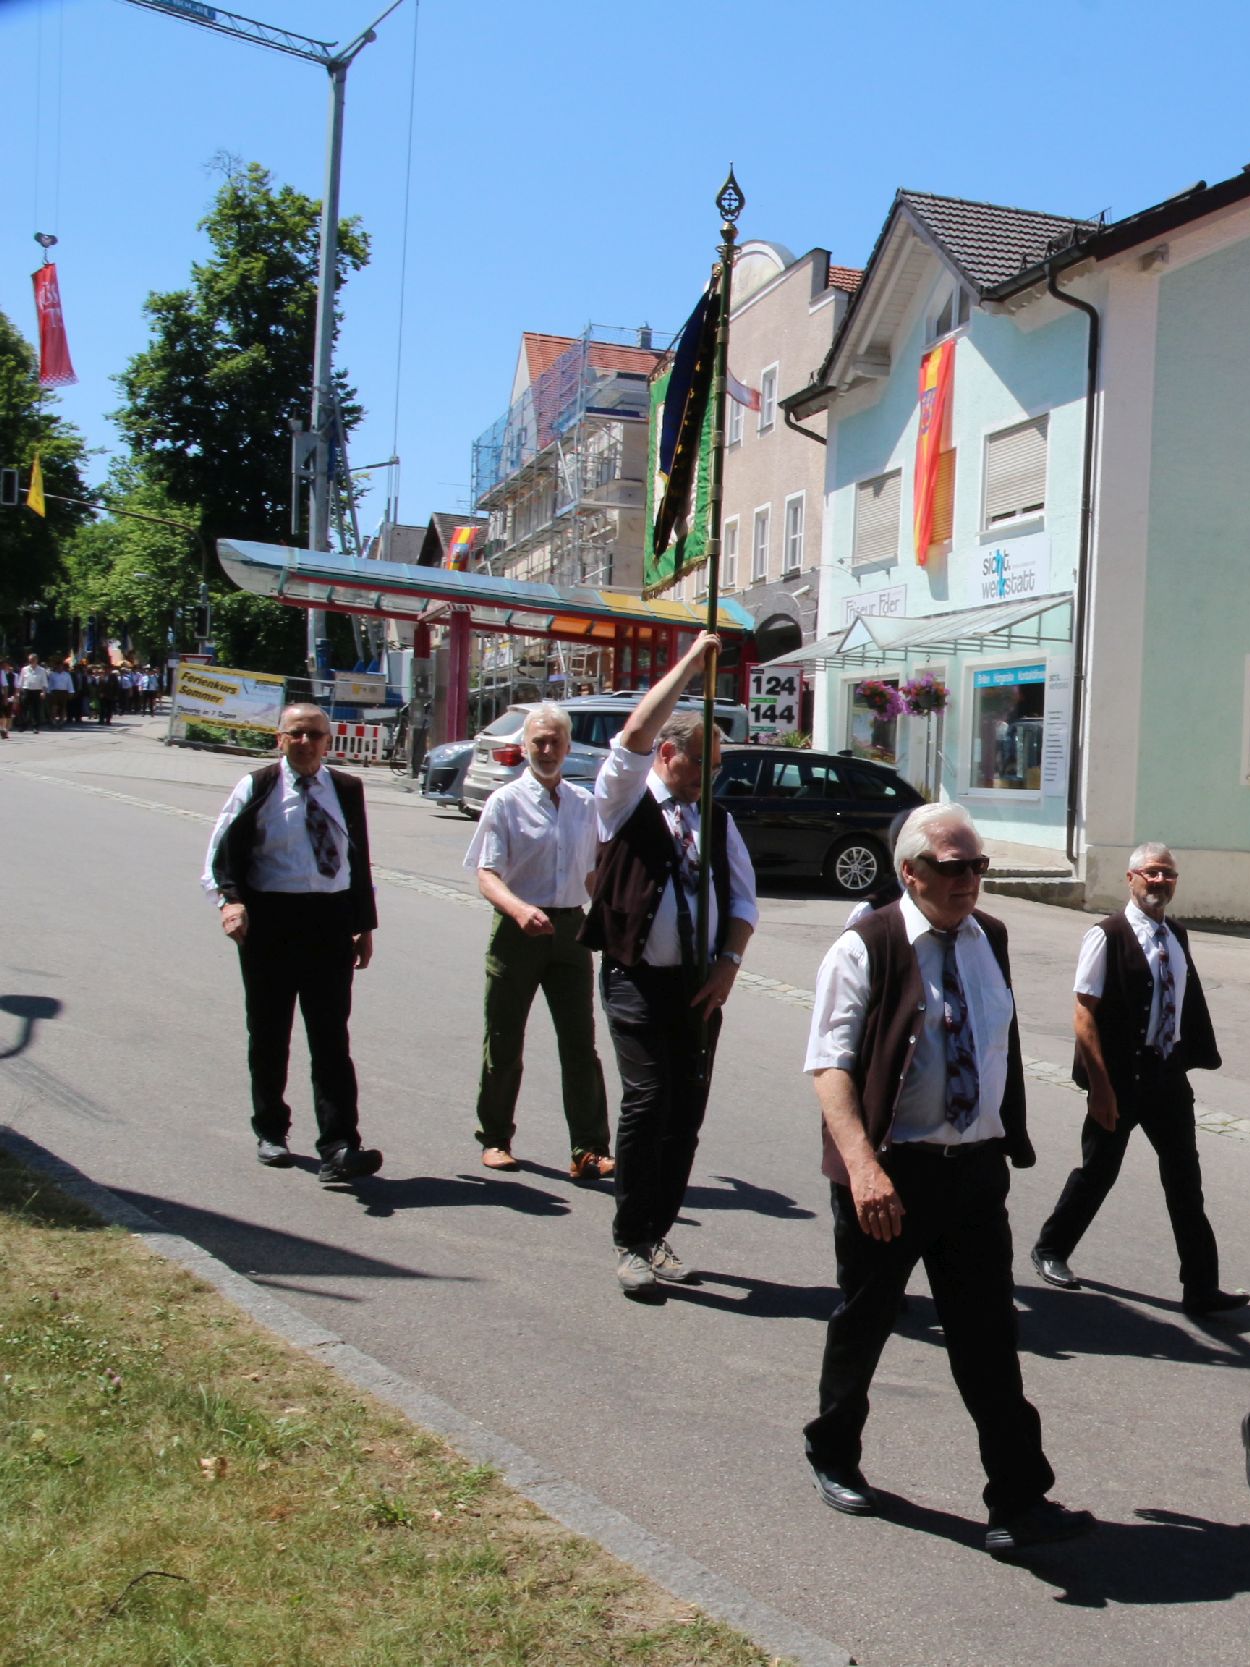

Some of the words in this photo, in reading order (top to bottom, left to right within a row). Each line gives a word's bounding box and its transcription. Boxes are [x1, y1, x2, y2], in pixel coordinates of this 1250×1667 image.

[181, 671, 238, 695] Ferienkurs
[178, 685, 223, 704] Sommer
[750, 703, 795, 724] 144
